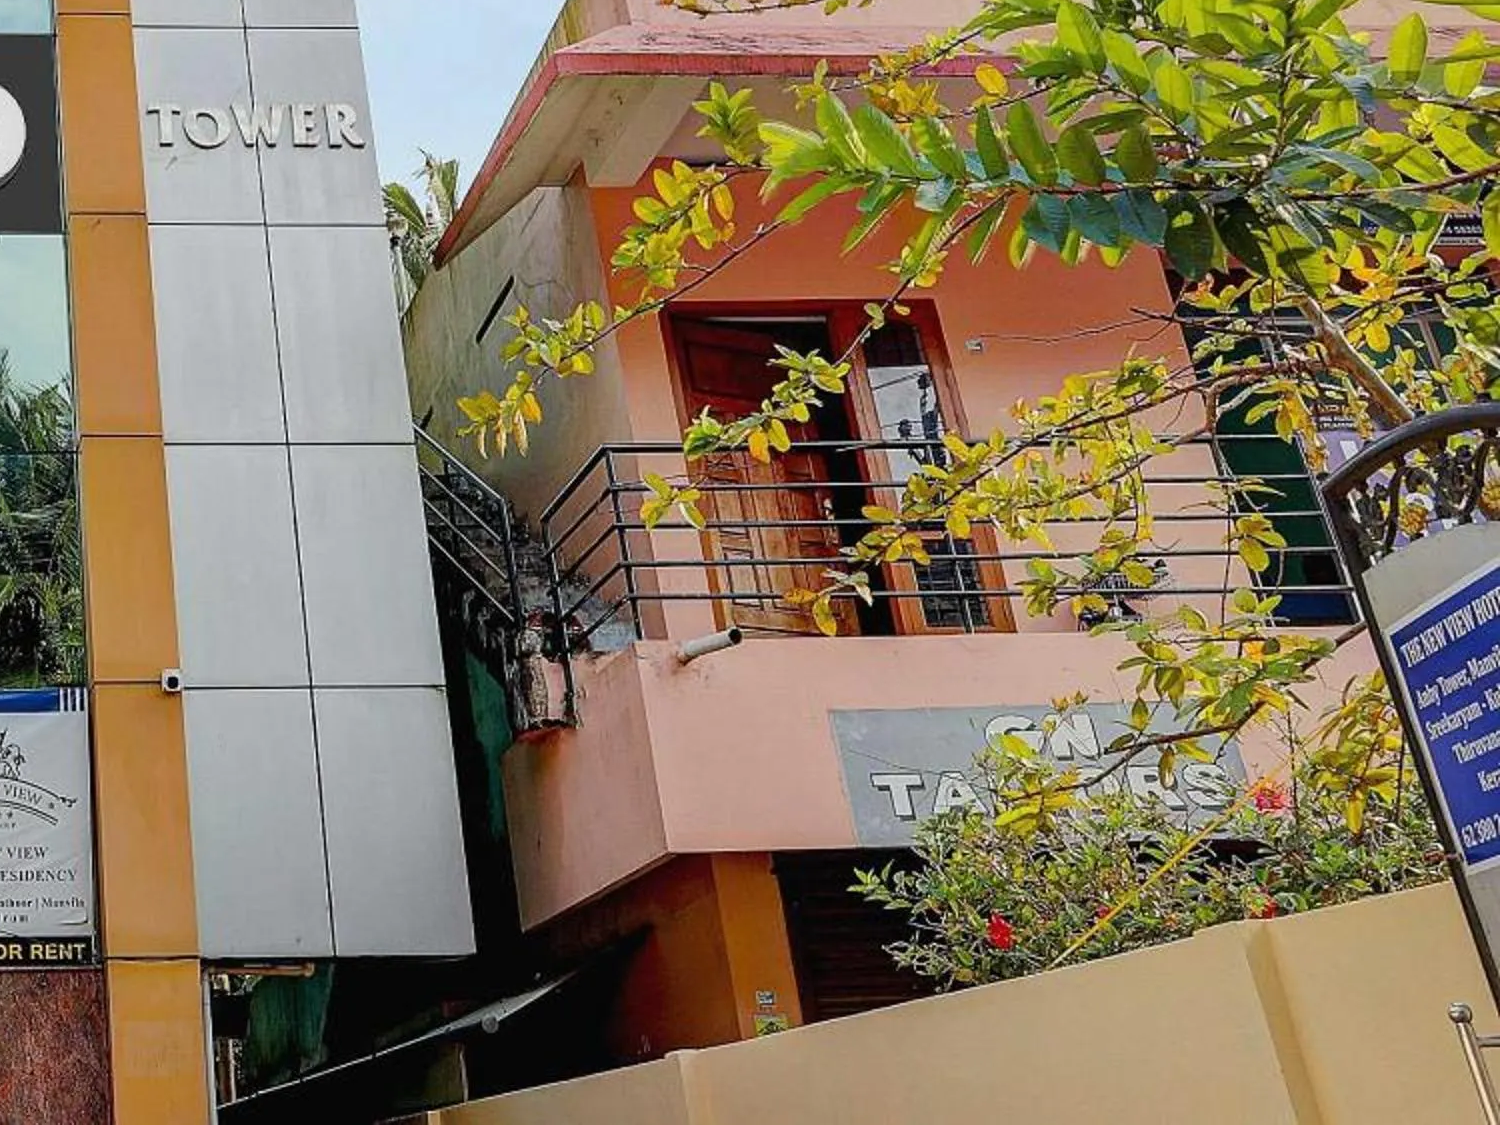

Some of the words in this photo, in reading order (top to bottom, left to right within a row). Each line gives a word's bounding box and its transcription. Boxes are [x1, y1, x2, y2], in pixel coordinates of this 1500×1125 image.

[146, 103, 366, 150] TOWER
[1400, 636, 1425, 668] THE
[1420, 622, 1447, 656] NEW
[1442, 604, 1476, 642] VIEW
[3, 784, 43, 806] VIEW
[7, 846, 49, 859] VIEW
[30, 943, 86, 960] RENT
